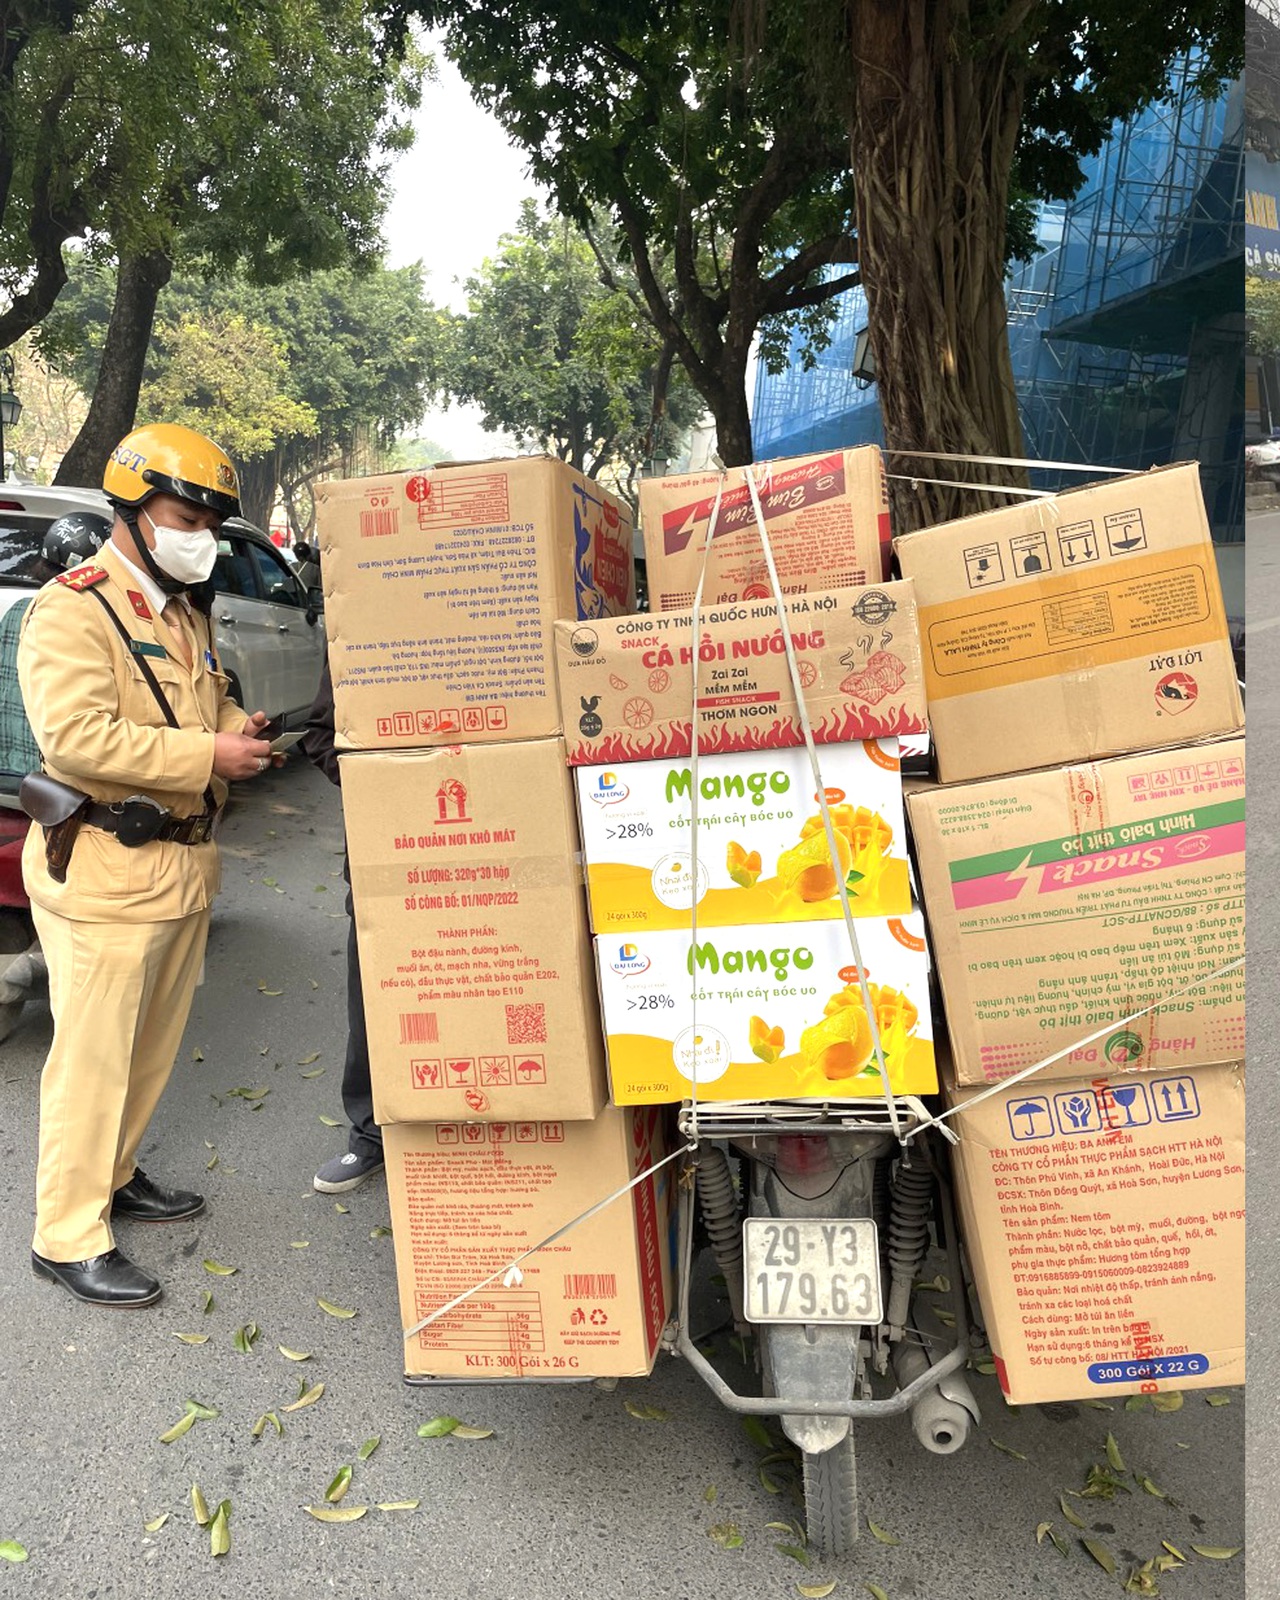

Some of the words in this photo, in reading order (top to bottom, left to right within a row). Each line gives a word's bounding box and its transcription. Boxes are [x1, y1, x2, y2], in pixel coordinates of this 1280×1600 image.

[616, 617, 653, 634] CÔNG
[657, 618, 670, 630] TY
[673, 613, 706, 628] TNHH
[709, 605, 748, 624] QUỐC
[792, 599, 813, 615] HÀ
[816, 597, 838, 613] NỘI
[621, 635, 660, 649] SNACK
[642, 642, 681, 669] CÁ
[684, 632, 726, 664] HỒI
[732, 628, 825, 660] NƯỚNG
[711, 669, 728, 680] Zai
[731, 667, 749, 678] Zai
[705, 680, 730, 695] MỀM
[733, 678, 757, 692] MỀM
[701, 706, 737, 722] THƠM
[740, 704, 777, 718] NGON
[665, 768, 790, 806] Mango
[606, 823, 653, 839] >28%
[1118, 821, 1155, 843] balô
[1158, 812, 1196, 834] Hình
[393, 833, 415, 849] BẢO
[416, 832, 446, 848] QUẢN
[448, 832, 467, 845] NƠI
[469, 829, 490, 844] KHÔ
[492, 827, 516, 842] MÁT
[1060, 837, 1083, 856] bò
[1085, 827, 1115, 850] thịt
[406, 866, 419, 883] SỐ
[420, 868, 453, 885] LƯỢNG:
[492, 864, 510, 880] hộp
[1050, 845, 1166, 885] Snack
[404, 893, 417, 910] SỐ
[417, 893, 442, 909] CÔNG
[443, 890, 459, 907] BỐ:
[1203, 902, 1221, 915] số
[436, 927, 467, 938] THÀNH
[469, 923, 497, 937] PHẦN:
[1151, 921, 1183, 938] tháng
[1185, 923, 1192, 932] 6
[410, 949, 426, 958] Bột
[427, 948, 443, 958] đậu
[445, 946, 469, 956] nành,
[471, 944, 499, 955] đường
[500, 943, 522, 953] kính,
[687, 941, 814, 981] Mango
[417, 988, 441, 1001] phẩm
[442, 990, 461, 998] màu
[462, 988, 484, 997] nhân
[486, 988, 500, 996] tạo
[502, 986, 523, 995] E110
[626, 994, 675, 1010] >28%
[1197, 992, 1232, 1011] phẩm:
[1084, 1009, 1115, 1024] balô
[1151, 999, 1195, 1017] Snack
[1038, 1017, 1056, 1030] bò
[1058, 1011, 1081, 1027] thịt
[988, 1147, 1008, 1160] TÊN
[1009, 1143, 1049, 1158] THƯƠNG
[1051, 1140, 1078, 1154] HIỆU:
[1079, 1139, 1093, 1149] BA
[1118, 1134, 1133, 1144] EM
[991, 1160, 1019, 1174] CÔNG
[1020, 1160, 1034, 1170] TY
[1034, 1156, 1050, 1169] CỔ
[1051, 1153, 1078, 1168] PHẦN
[1080, 1151, 1107, 1165] THỰC
[1108, 1144, 1137, 1161] PHẨM
[1138, 1145, 1166, 1158] SẠCH
[1167, 1142, 1188, 1153] HTT
[1188, 1137, 1204, 1149] HÀ
[1205, 1134, 1223, 1148] NỘI
[1002, 1217, 1020, 1229] Tên
[1021, 1216, 1038, 1227] sản
[1039, 1211, 1069, 1229] phẩm:
[1070, 1212, 1091, 1223] Nem
[1092, 1210, 1111, 1221] tôm
[764, 1225, 858, 1267] 29-Y3
[757, 1272, 872, 1315] 179.63
[465, 1355, 494, 1367] KLT:
[497, 1356, 516, 1368] 300
[519, 1355, 541, 1368] Gói
[553, 1356, 566, 1368] 26
[569, 1356, 579, 1368] G
[1097, 1366, 1122, 1379] 300
[1125, 1363, 1151, 1377] Gói
[1153, 1363, 1164, 1373] X
[1167, 1361, 1184, 1372] 22
[1187, 1359, 1200, 1370] G
